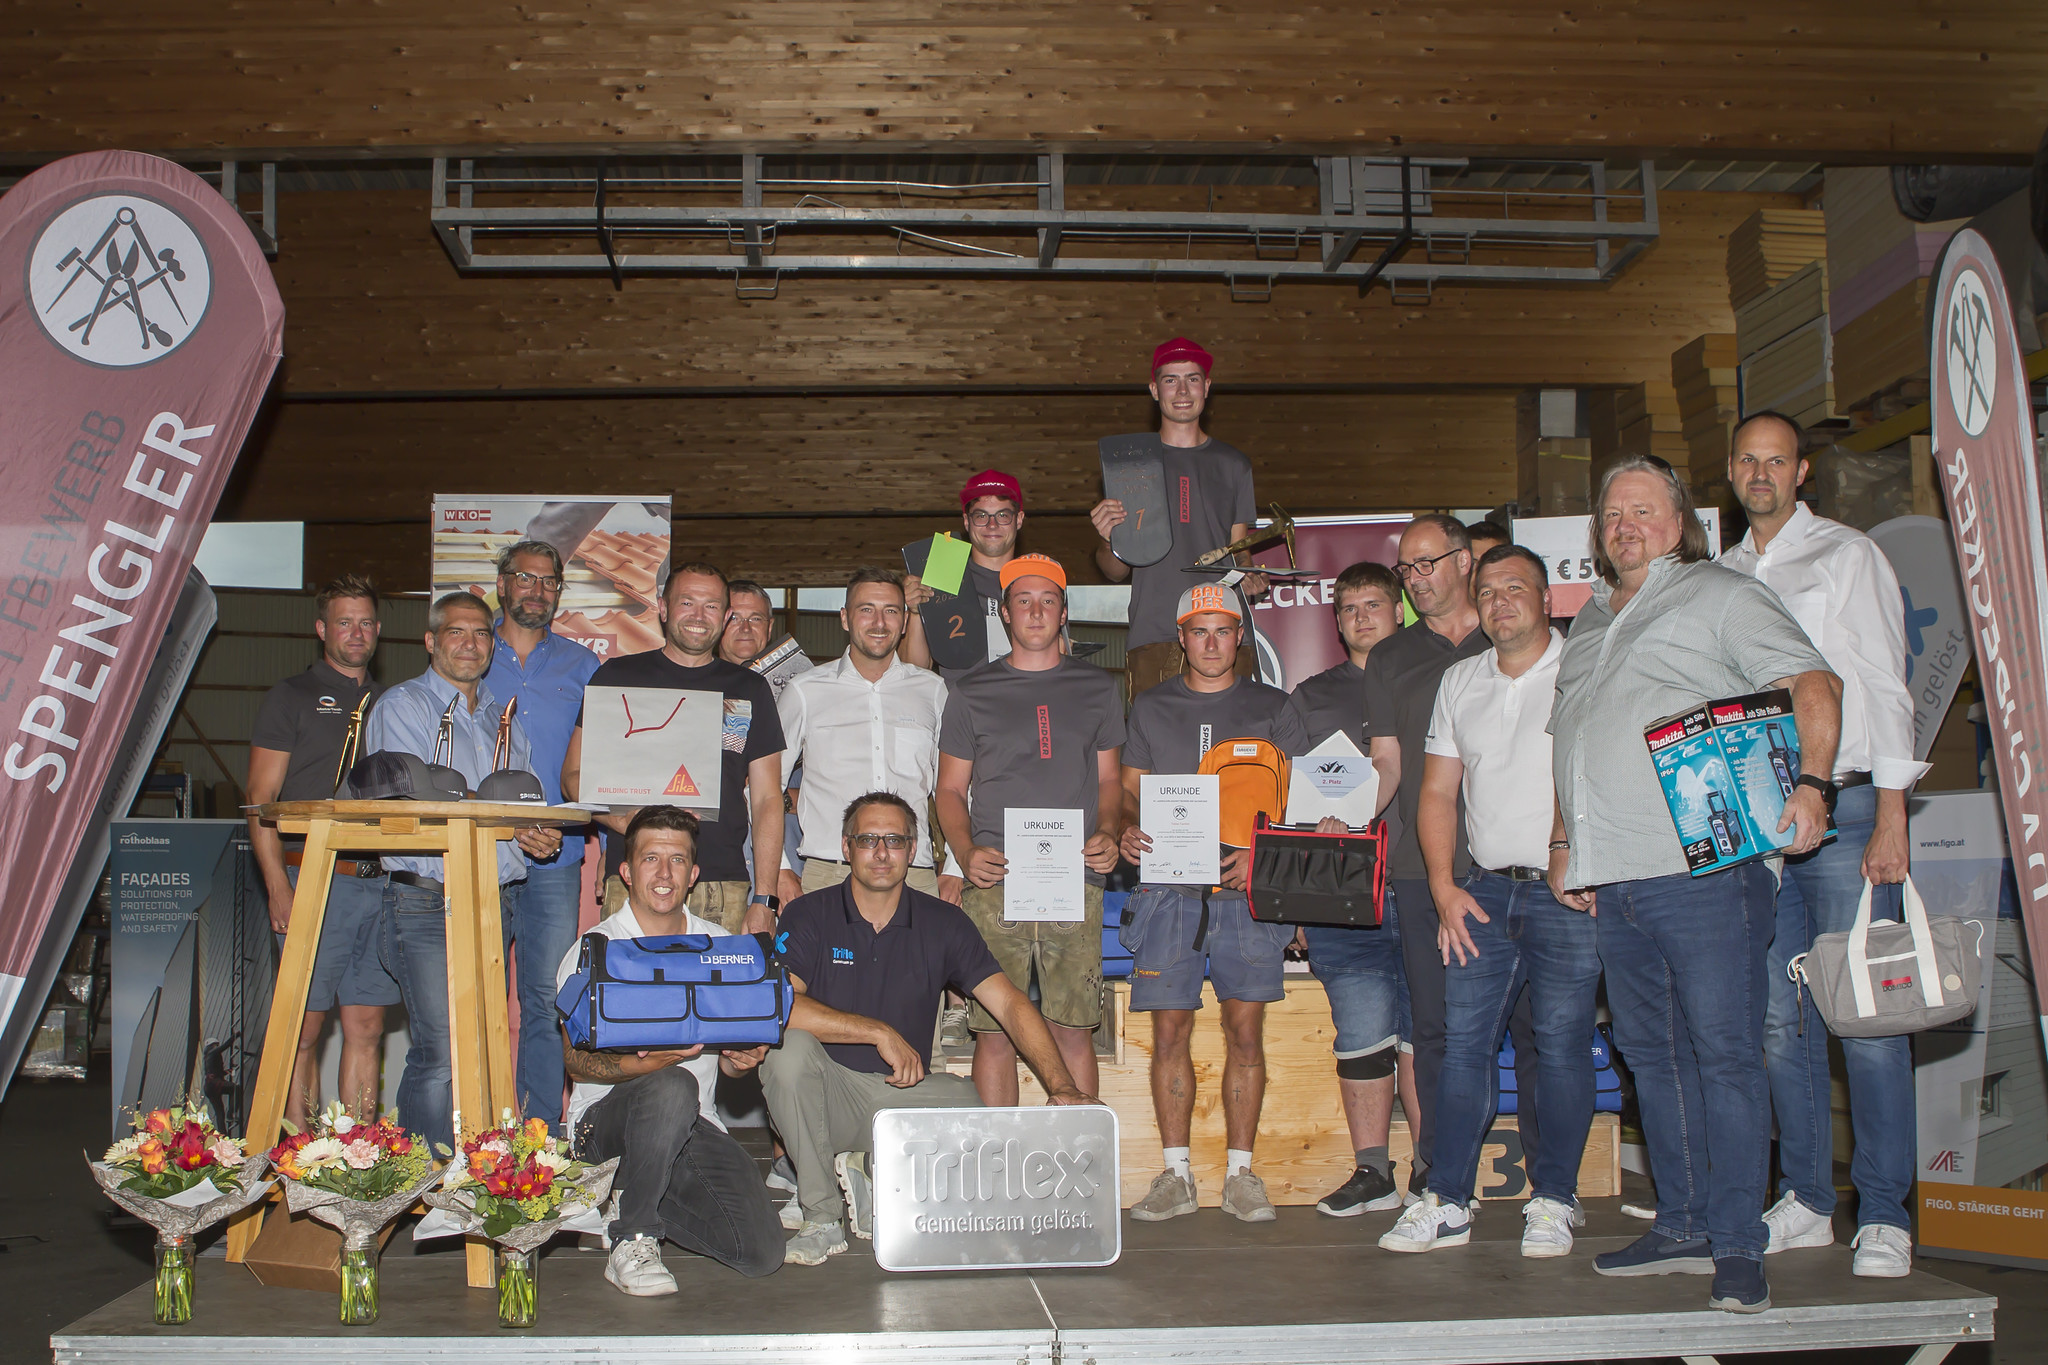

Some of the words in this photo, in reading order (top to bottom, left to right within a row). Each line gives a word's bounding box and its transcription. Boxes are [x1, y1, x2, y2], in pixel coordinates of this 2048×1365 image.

[445, 511, 478, 520] WKO
[1191, 586, 1224, 599] BAU
[3, 411, 216, 793] SPENGLER
[1191, 597, 1224, 611] DER
[948, 615, 966, 639] 2
[1039, 708, 1050, 756] DCHDCKR
[1202, 726, 1210, 755] SPNGL
[667, 774, 695, 793] Sika
[1160, 787, 1200, 795] URKUNDE
[1024, 821, 1065, 830] URKUNDE
[120, 836, 170, 845] rothoblaas
[1920, 838, 1965, 848] www.figo.at
[121, 873, 190, 887] FAÇADES
[120, 890, 172, 899] SOLUTIONS
[174, 890, 193, 898] FOR
[120, 901, 181, 911] PROTECTION,
[120, 912, 199, 921] WATERPROOFING
[120, 924, 140, 933] AND
[143, 924, 178, 933] SAFETY
[712, 954, 755, 965] BERNER
[832, 947, 854, 960] Trifle
[1482, 1129, 1527, 1198] 3
[902, 1138, 1095, 1203] Triflex
[1925, 1198, 1956, 1211] FIGO.
[1958, 1200, 2010, 1216] STÄRKER
[2012, 1206, 2046, 1219] GEHT
[912, 1212, 1025, 1234] Gemeinsam
[1031, 1209, 1095, 1236] gelöst.
